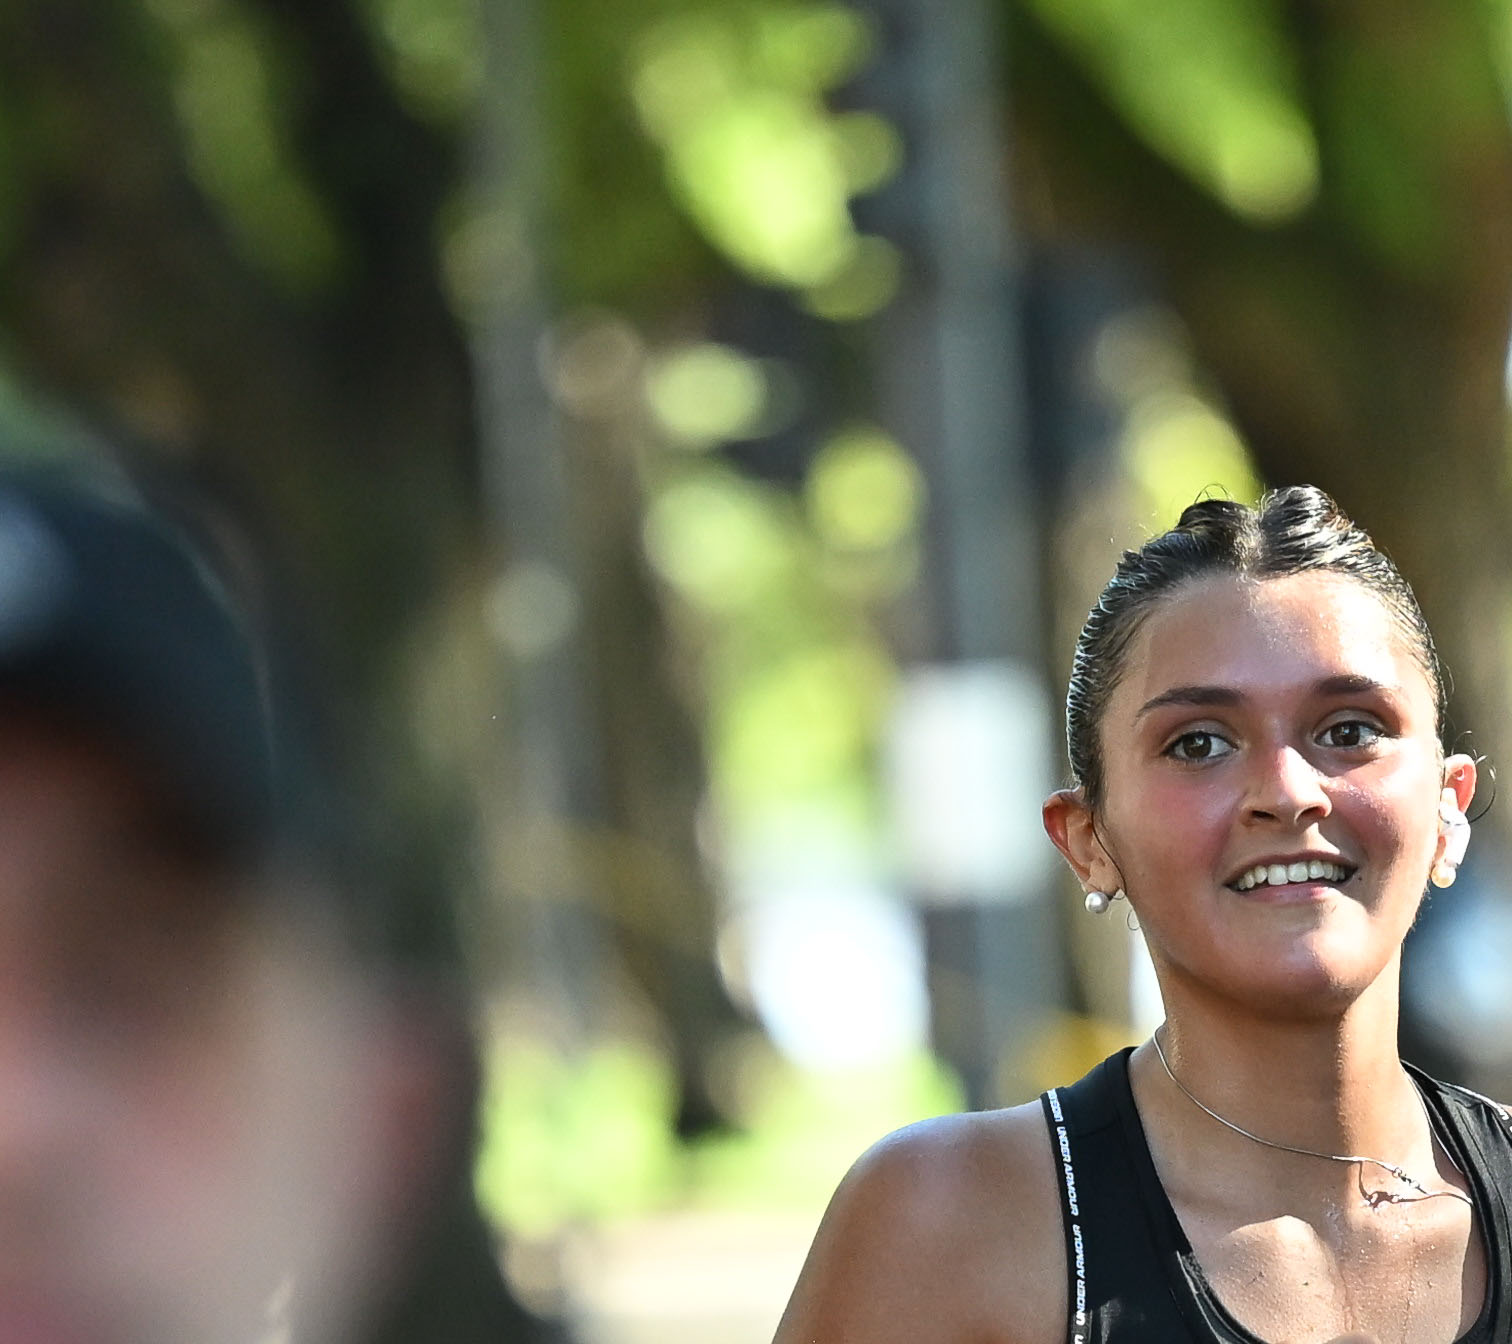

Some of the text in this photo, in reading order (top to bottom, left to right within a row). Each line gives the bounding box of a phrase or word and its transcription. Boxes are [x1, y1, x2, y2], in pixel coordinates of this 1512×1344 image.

[1056, 1126, 1079, 1217] UNDER ARMOUR
[1072, 1223, 1086, 1327] UNDER ARMOUR
